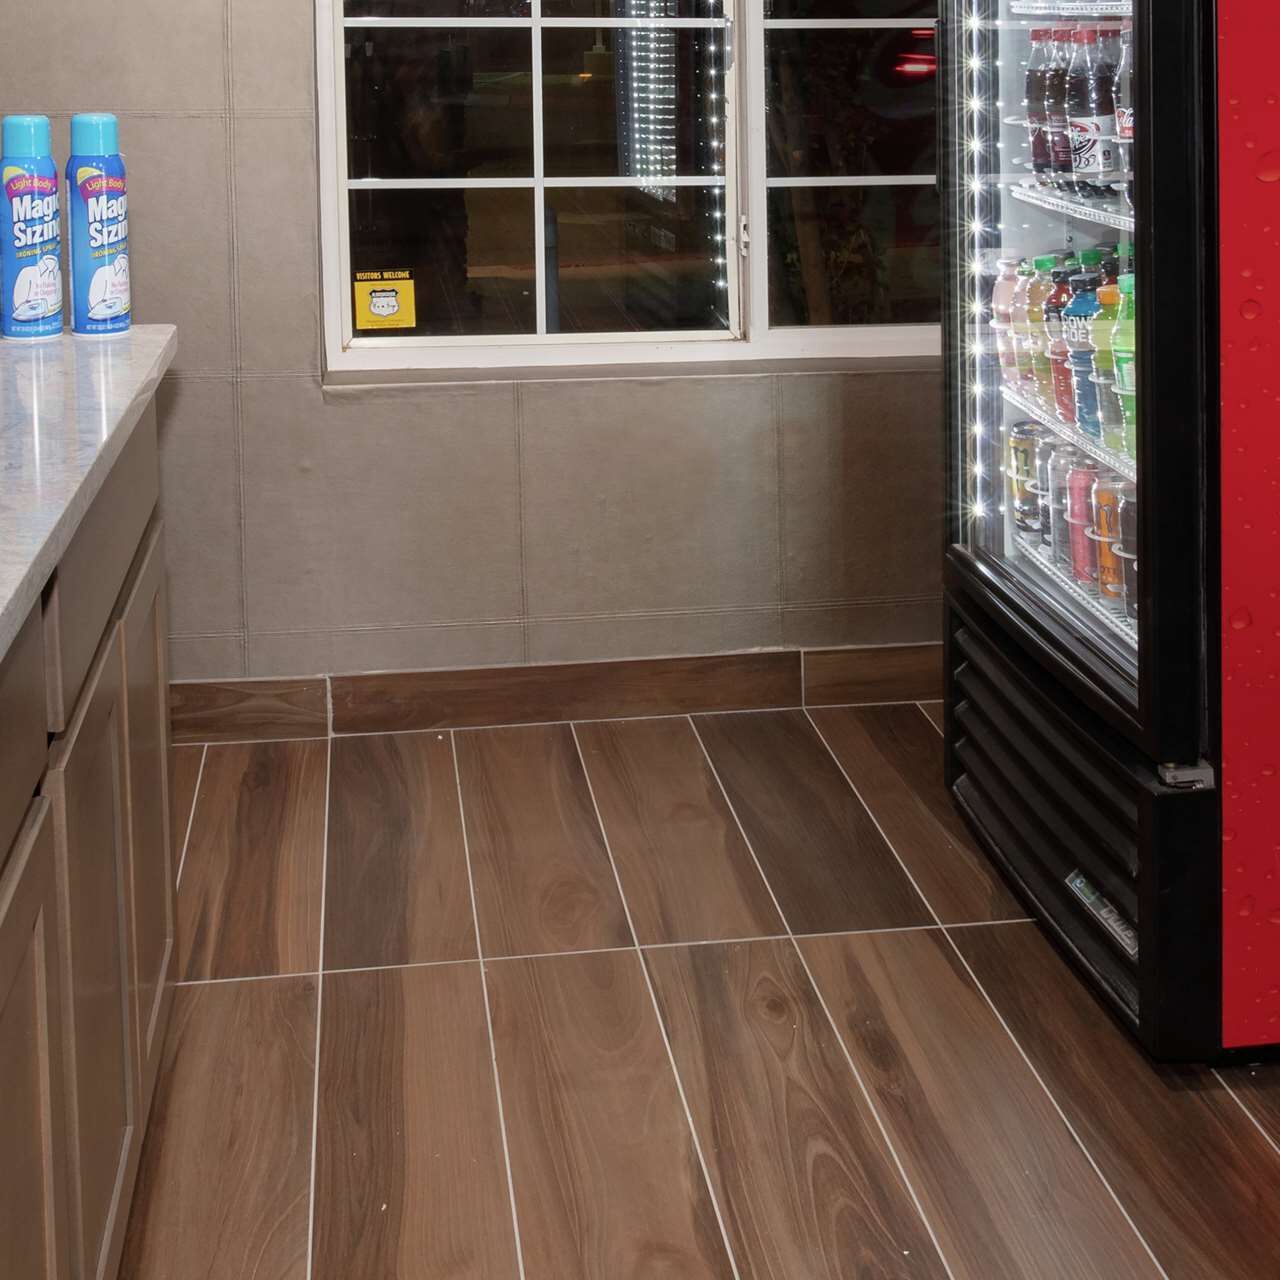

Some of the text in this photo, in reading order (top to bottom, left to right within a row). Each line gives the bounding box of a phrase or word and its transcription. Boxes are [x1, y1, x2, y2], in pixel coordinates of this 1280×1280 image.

[11, 177, 53, 193] Light Body
[86, 178, 107, 192] Light
[356, 271, 410, 280] VISITORS WELCOME
